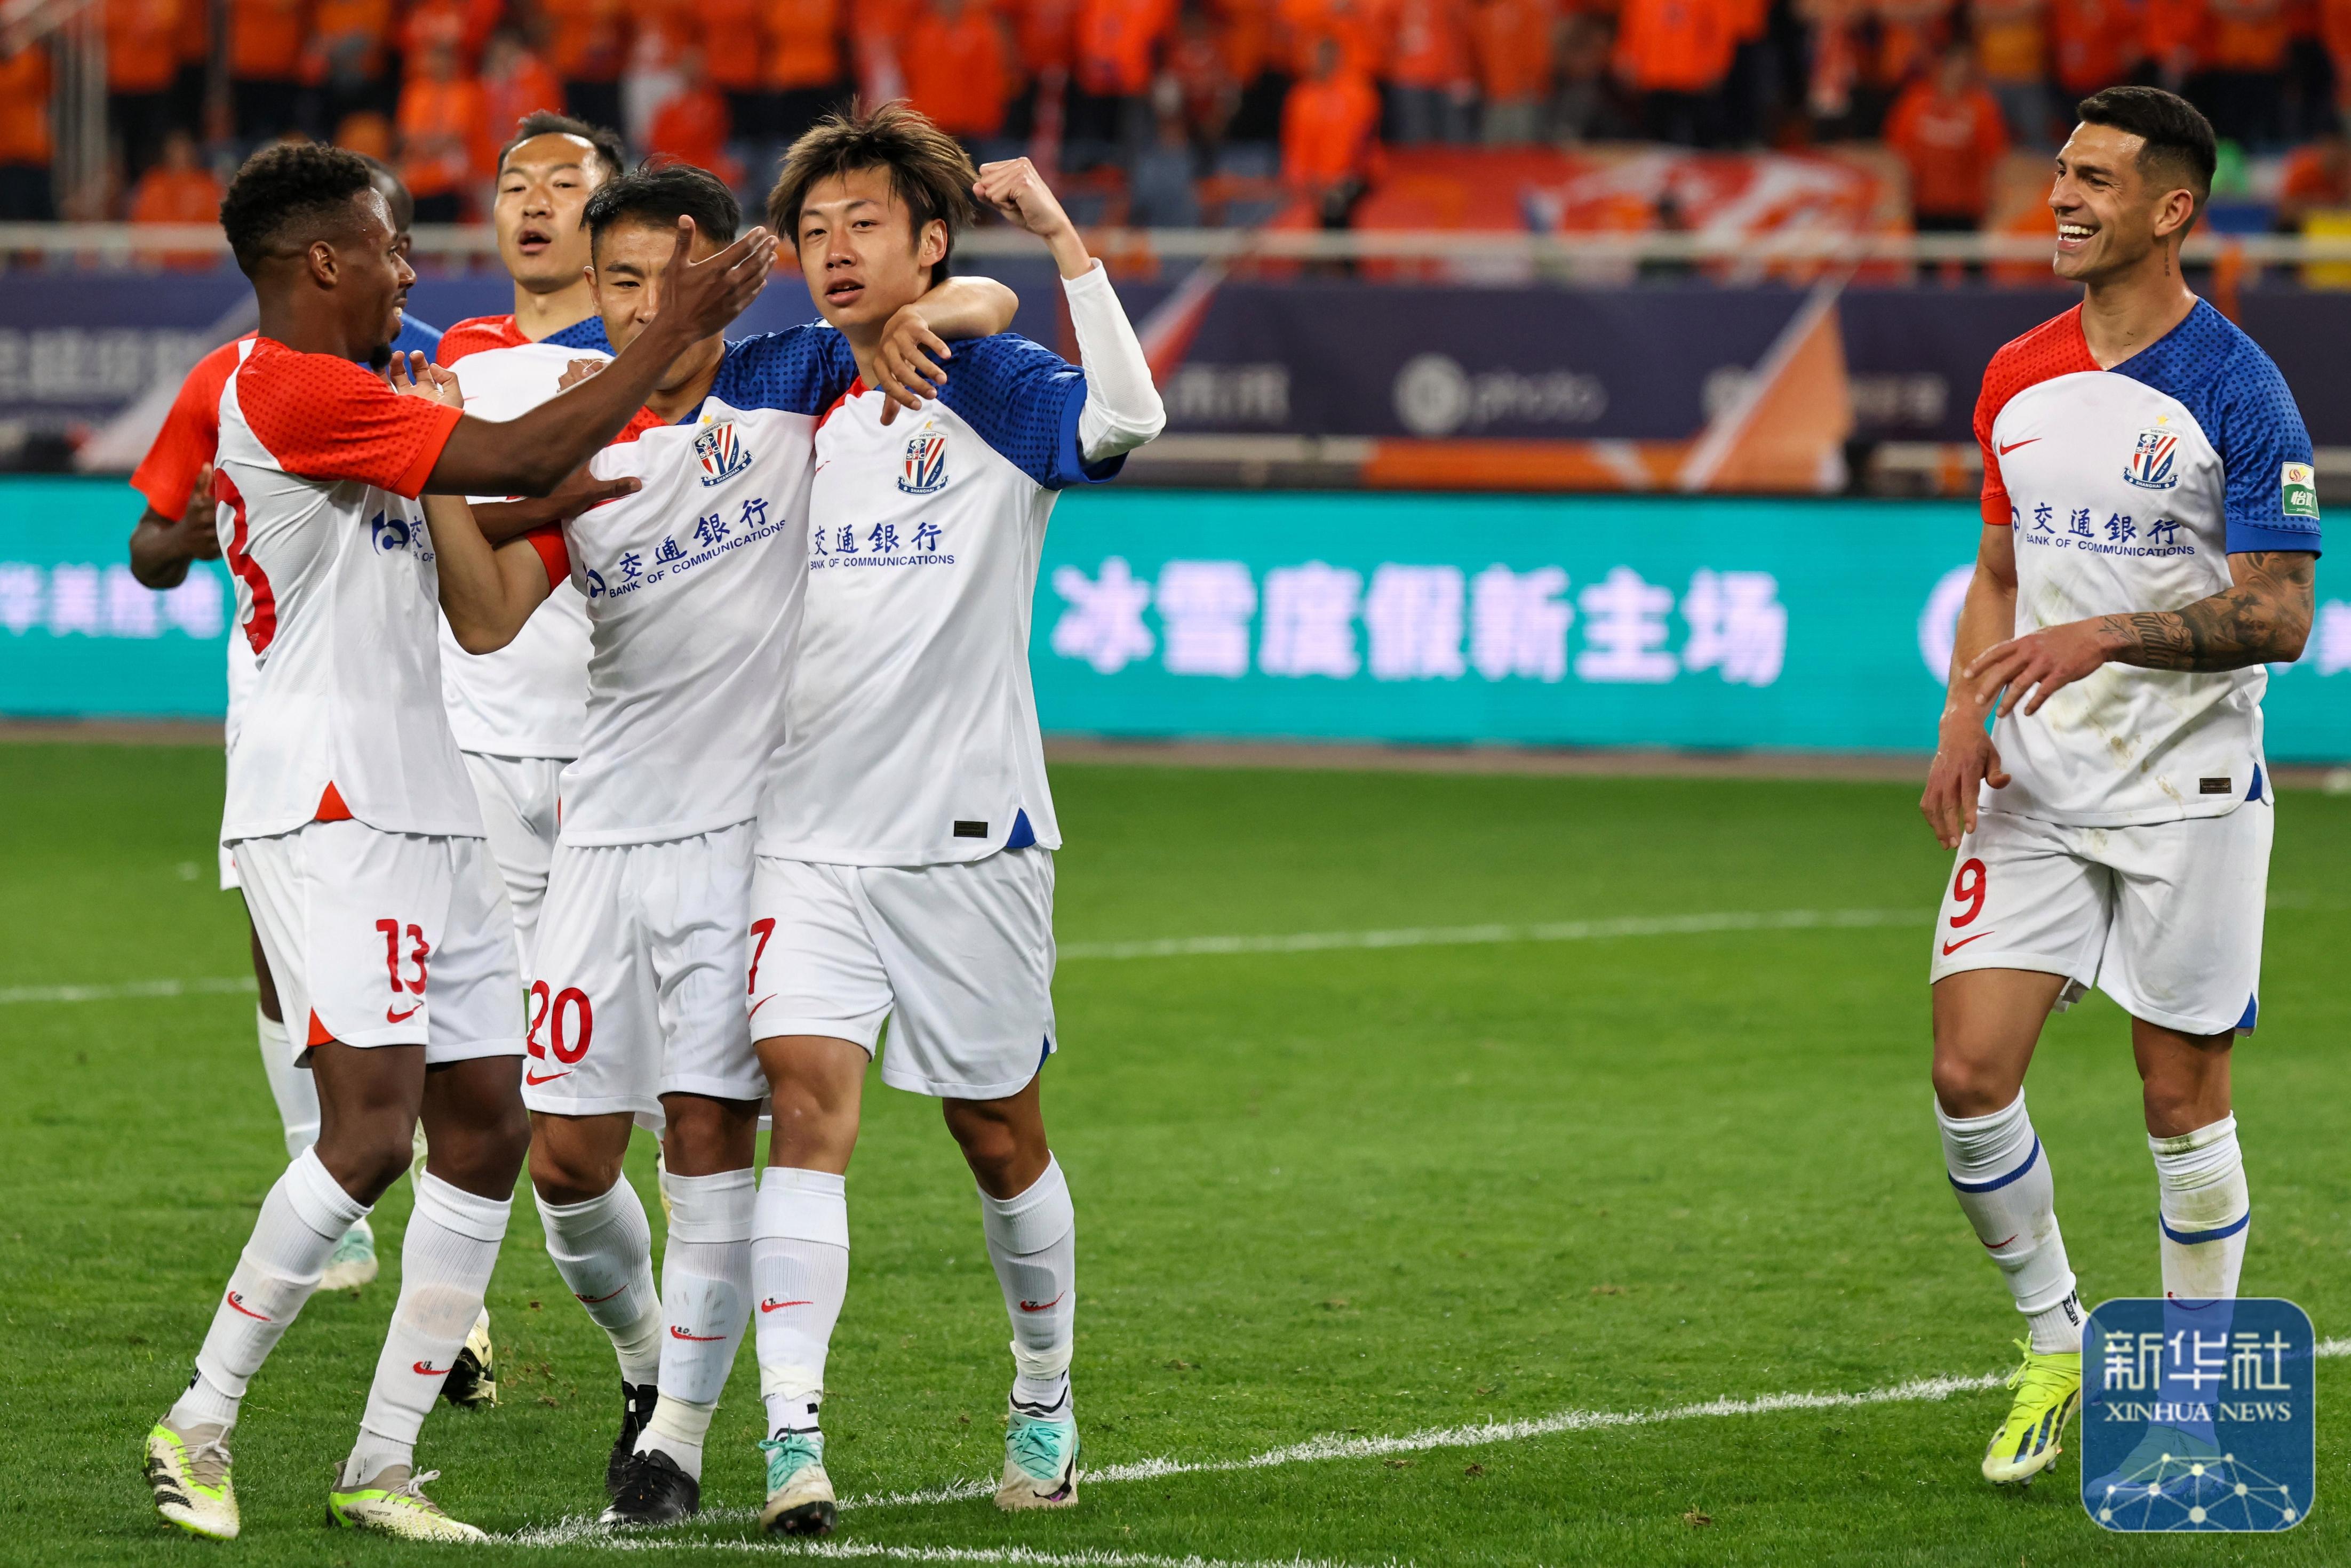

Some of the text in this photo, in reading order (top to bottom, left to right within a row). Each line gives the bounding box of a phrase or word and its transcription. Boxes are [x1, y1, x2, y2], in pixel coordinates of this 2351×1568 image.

[702, 423, 721, 435] SHENHUA
[716, 467, 740, 483] SHANGHAI
[2135, 481, 2162, 489] SHANGHAI
[619, 498, 769, 583] 交通銀行
[814, 522, 943, 556] 交通銀行
[2027, 533, 2195, 557] BANK OF COMMUNICATIONS
[2032, 502, 2181, 545] 交通銀行
[609, 519, 786, 598] BANK OF COMMUNICATIONS
[810, 555, 955, 570] BANK OF COMMUNICATIONS
[1050, 555, 1788, 687] 冰雪度假新主场
[1950, 858, 1987, 929] 9
[376, 918, 429, 995] 13
[748, 917, 776, 995] 7
[527, 980, 593, 1064] 20
